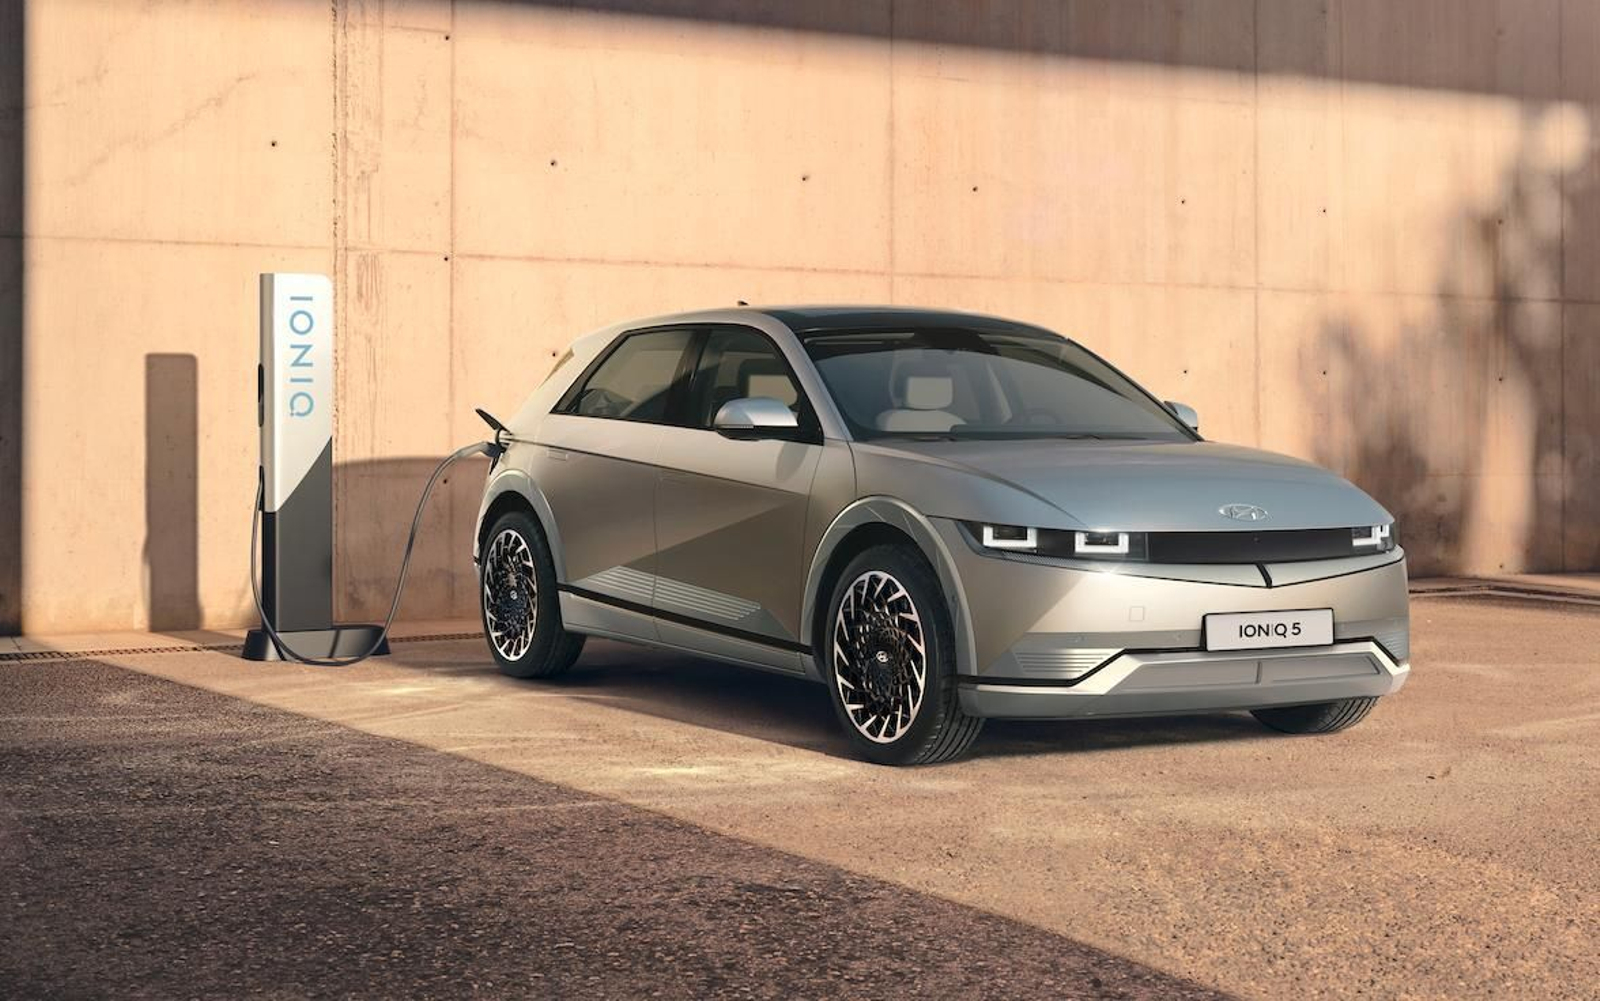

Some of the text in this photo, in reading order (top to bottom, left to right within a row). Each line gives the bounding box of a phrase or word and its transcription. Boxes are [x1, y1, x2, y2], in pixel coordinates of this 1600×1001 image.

[289, 296, 314, 417] IONIQ
[1239, 622, 1302, 639] IONIQ 5
